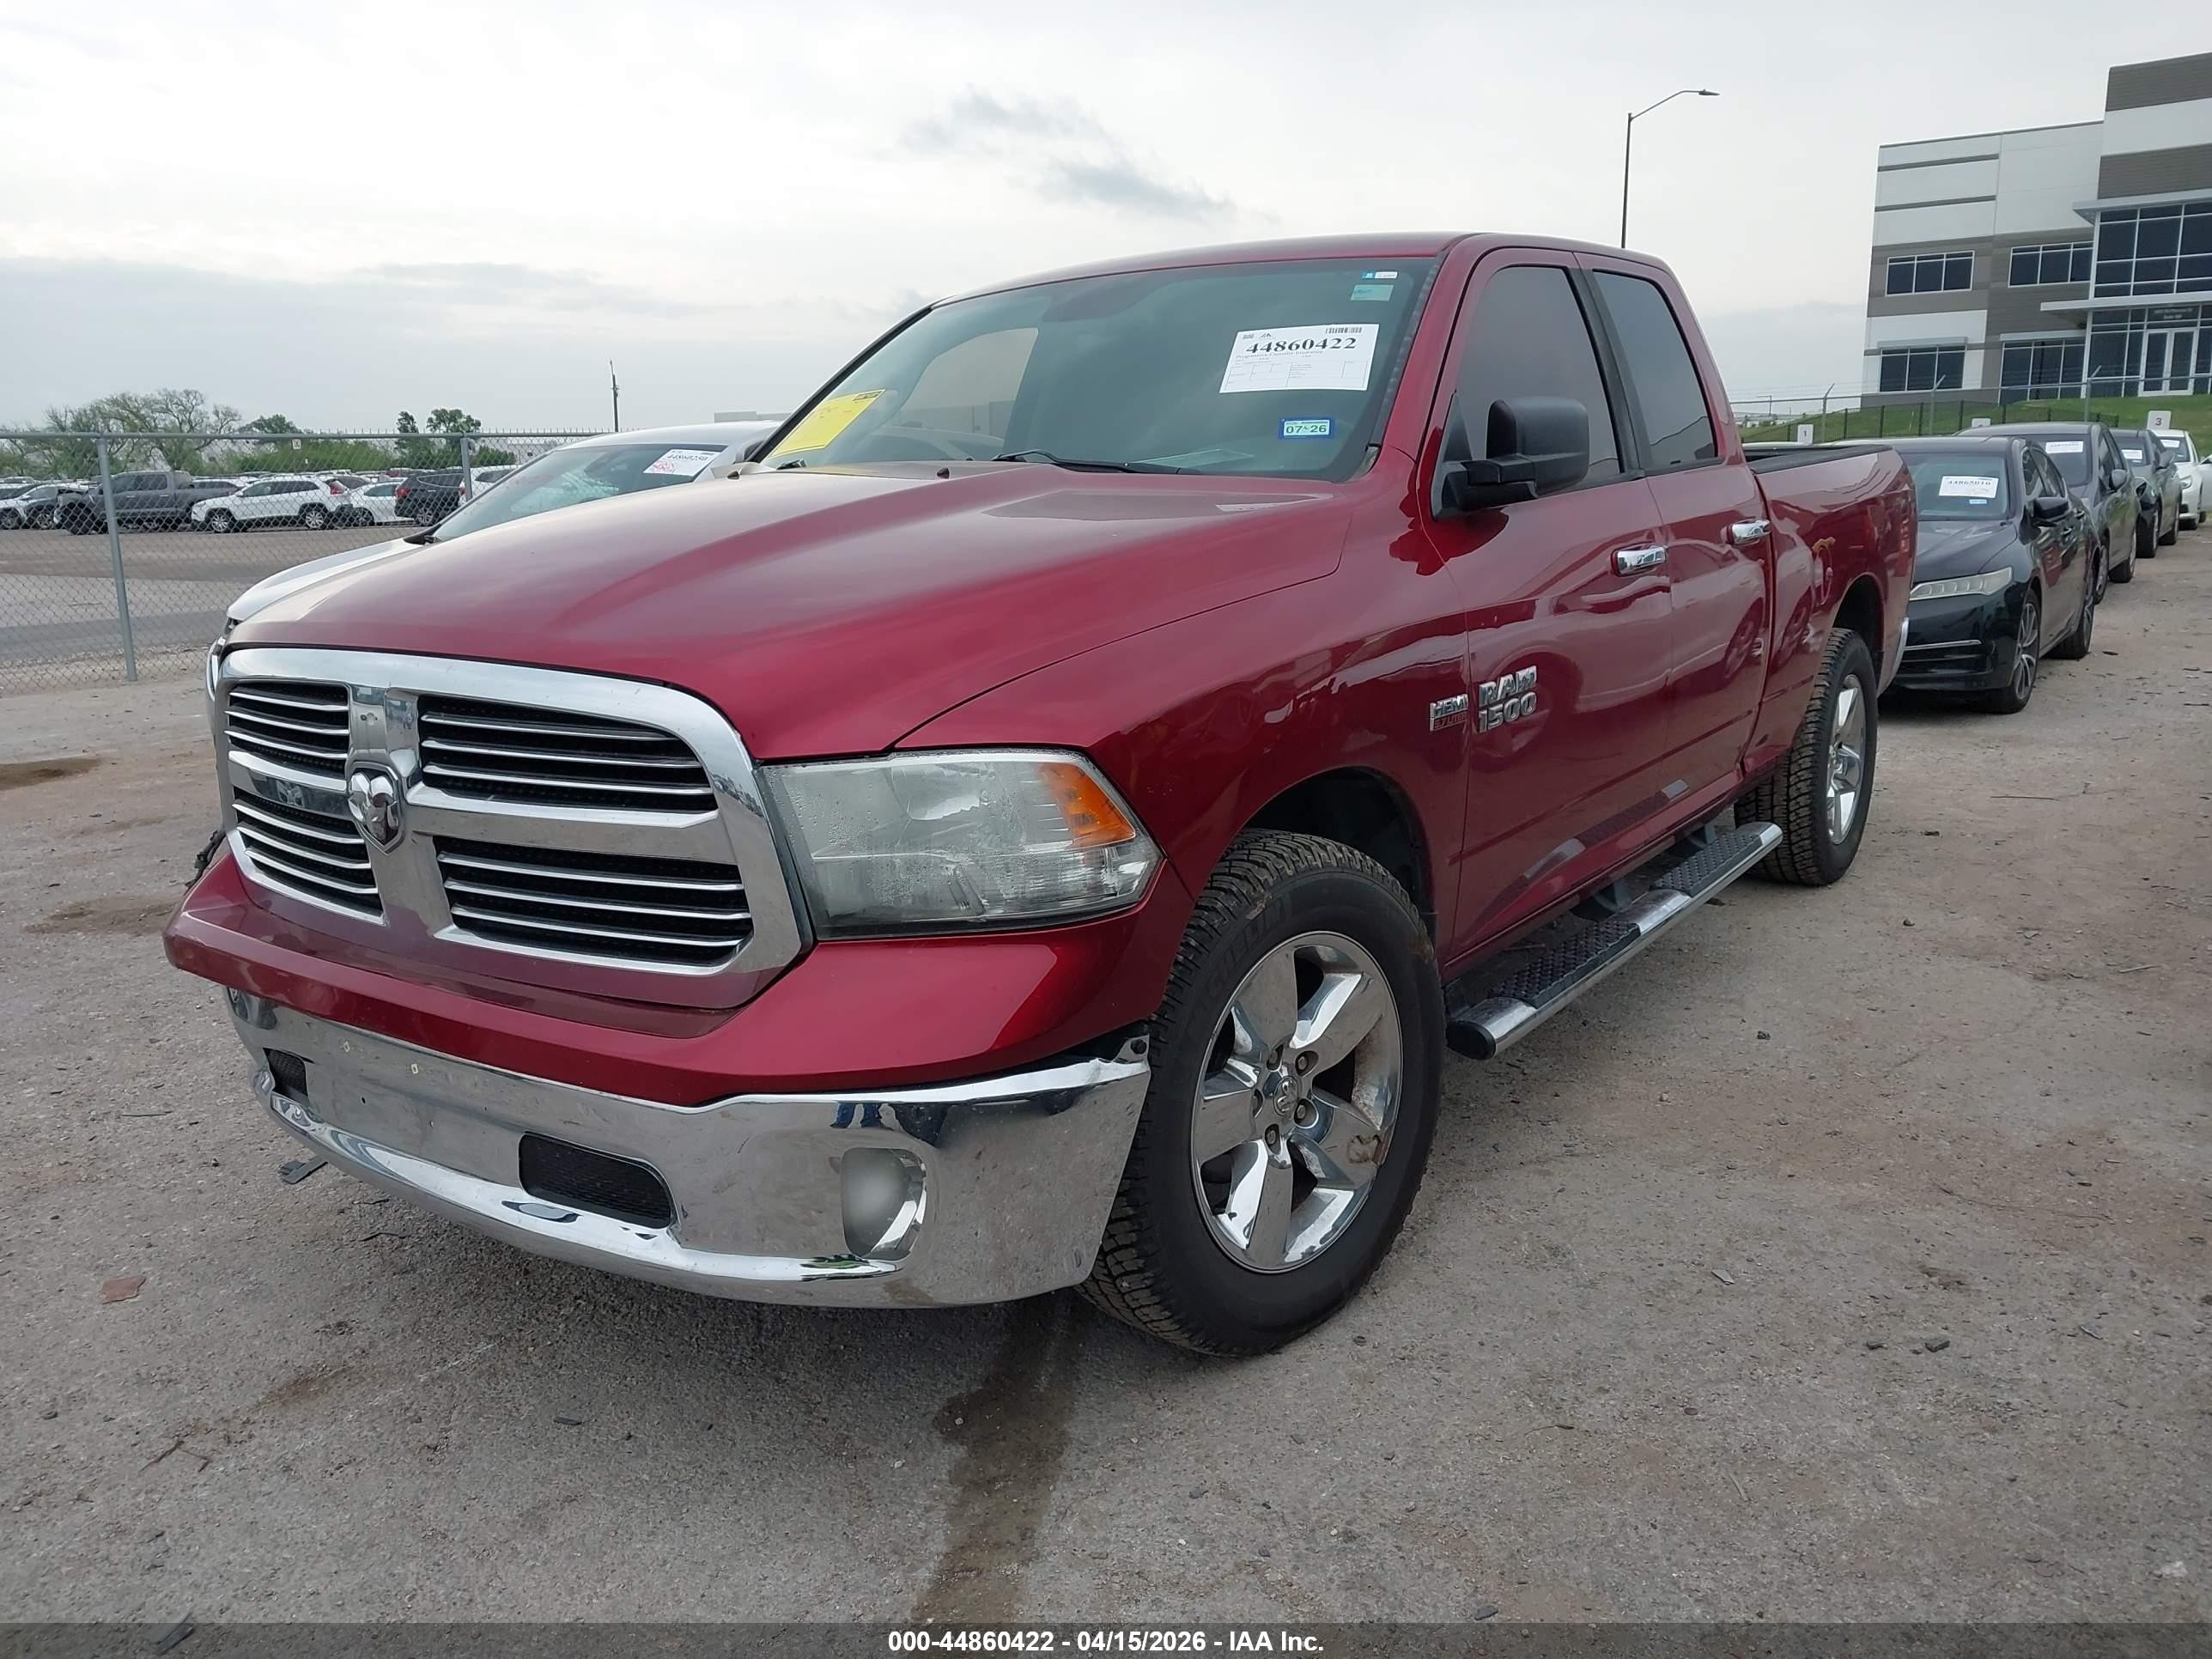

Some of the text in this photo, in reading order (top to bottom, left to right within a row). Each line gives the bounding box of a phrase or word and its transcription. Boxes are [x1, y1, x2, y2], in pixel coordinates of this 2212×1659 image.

[1246, 337, 1357, 354] 44860422
[1285, 424, 1327, 434] 07 26
[2155, 417, 2162, 426] 3
[1478, 665, 1537, 708] RAM
[1430, 694, 1468, 719] HEMI
[1478, 691, 1537, 733] 1500
